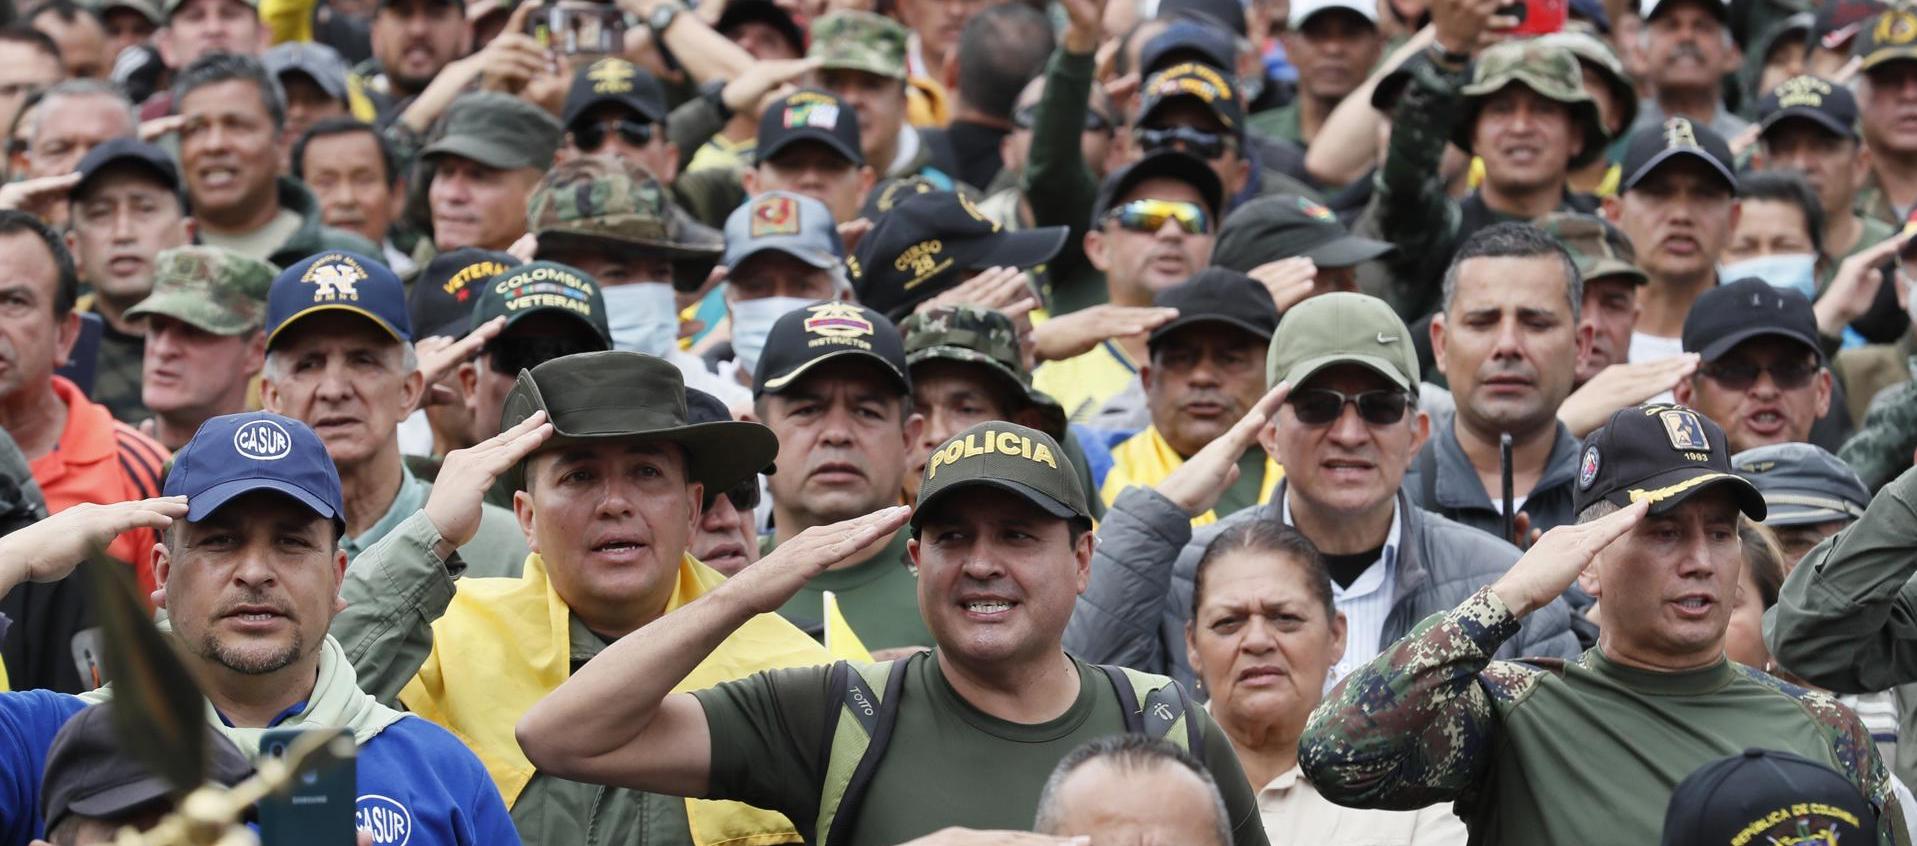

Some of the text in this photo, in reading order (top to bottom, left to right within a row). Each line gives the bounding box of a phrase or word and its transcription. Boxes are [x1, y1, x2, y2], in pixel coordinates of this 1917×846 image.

[895, 240, 942, 272] CURSO
[911, 254, 936, 277] 28
[443, 261, 510, 295] VETERA
[495, 268, 594, 296] COLOMBIA
[505, 293, 591, 315] VETERAN
[808, 336, 872, 351] INSTRUCTOR
[239, 426, 287, 454] CASUR
[929, 430, 1057, 480] POLICIA
[1791, 803, 1810, 816] DE
[355, 806, 406, 844] CASUR
